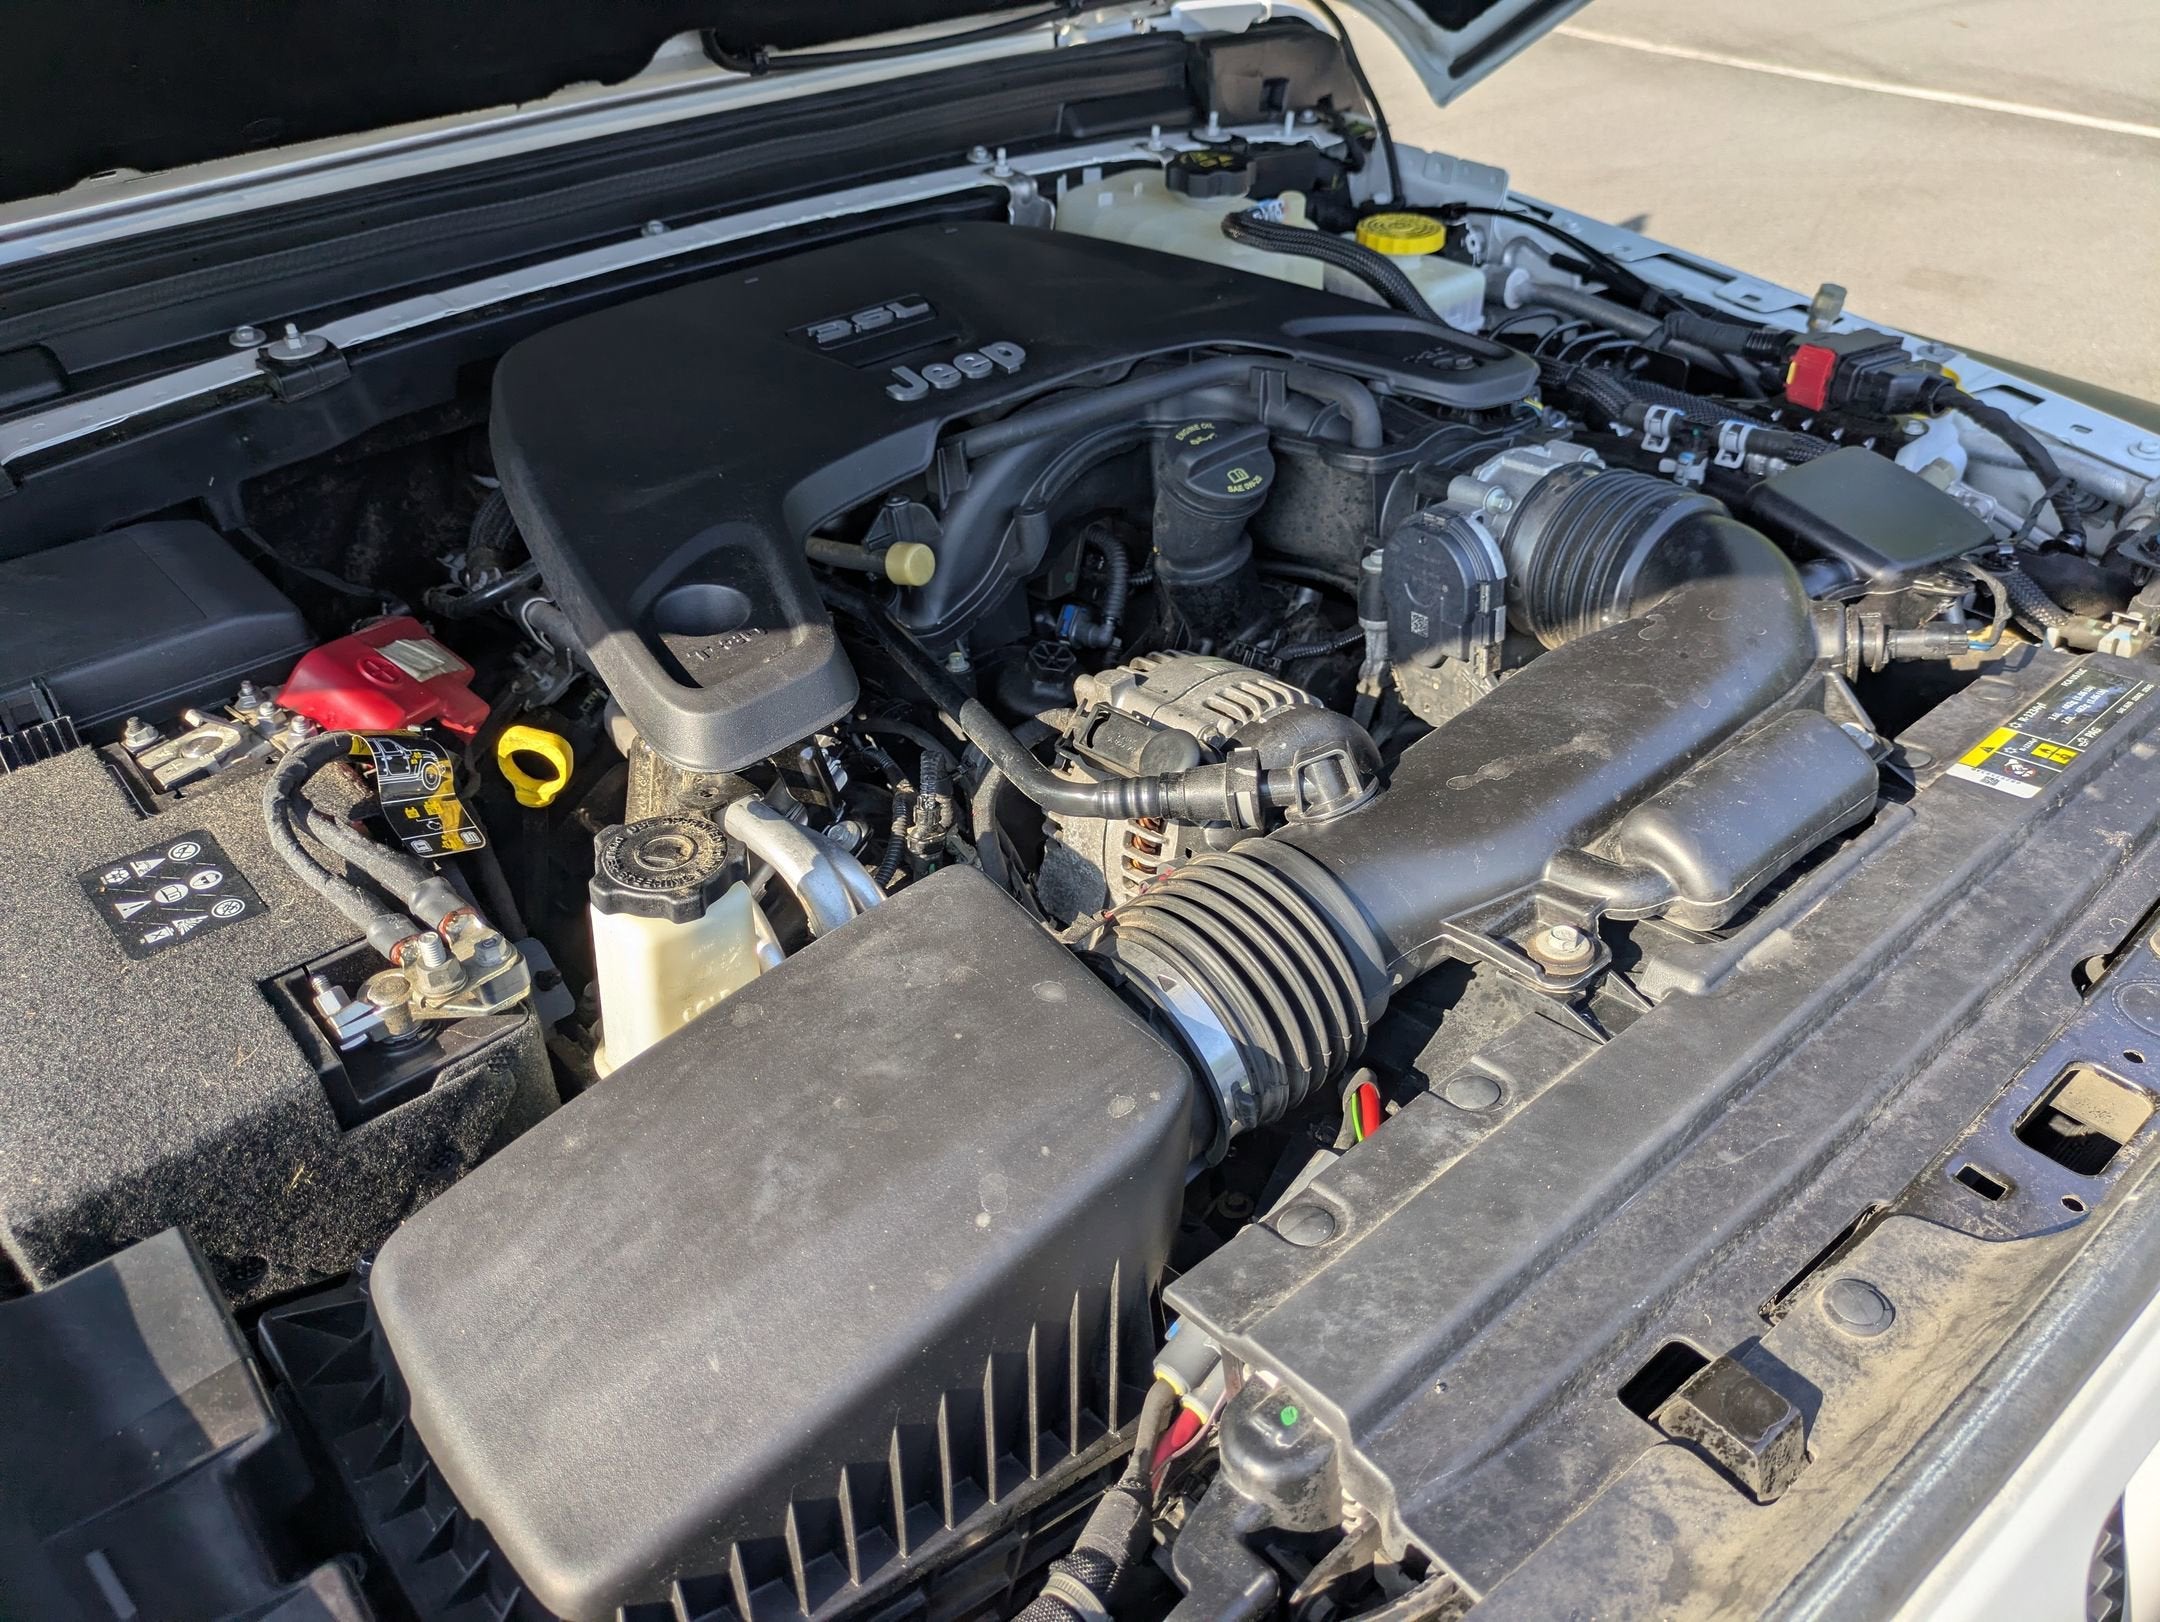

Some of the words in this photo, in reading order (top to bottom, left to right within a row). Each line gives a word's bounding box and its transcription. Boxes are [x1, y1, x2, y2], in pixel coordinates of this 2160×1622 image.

[807, 302, 930, 344] 3.6L
[885, 341, 1026, 401] Jeep
[2084, 726, 2102, 738] PAG
